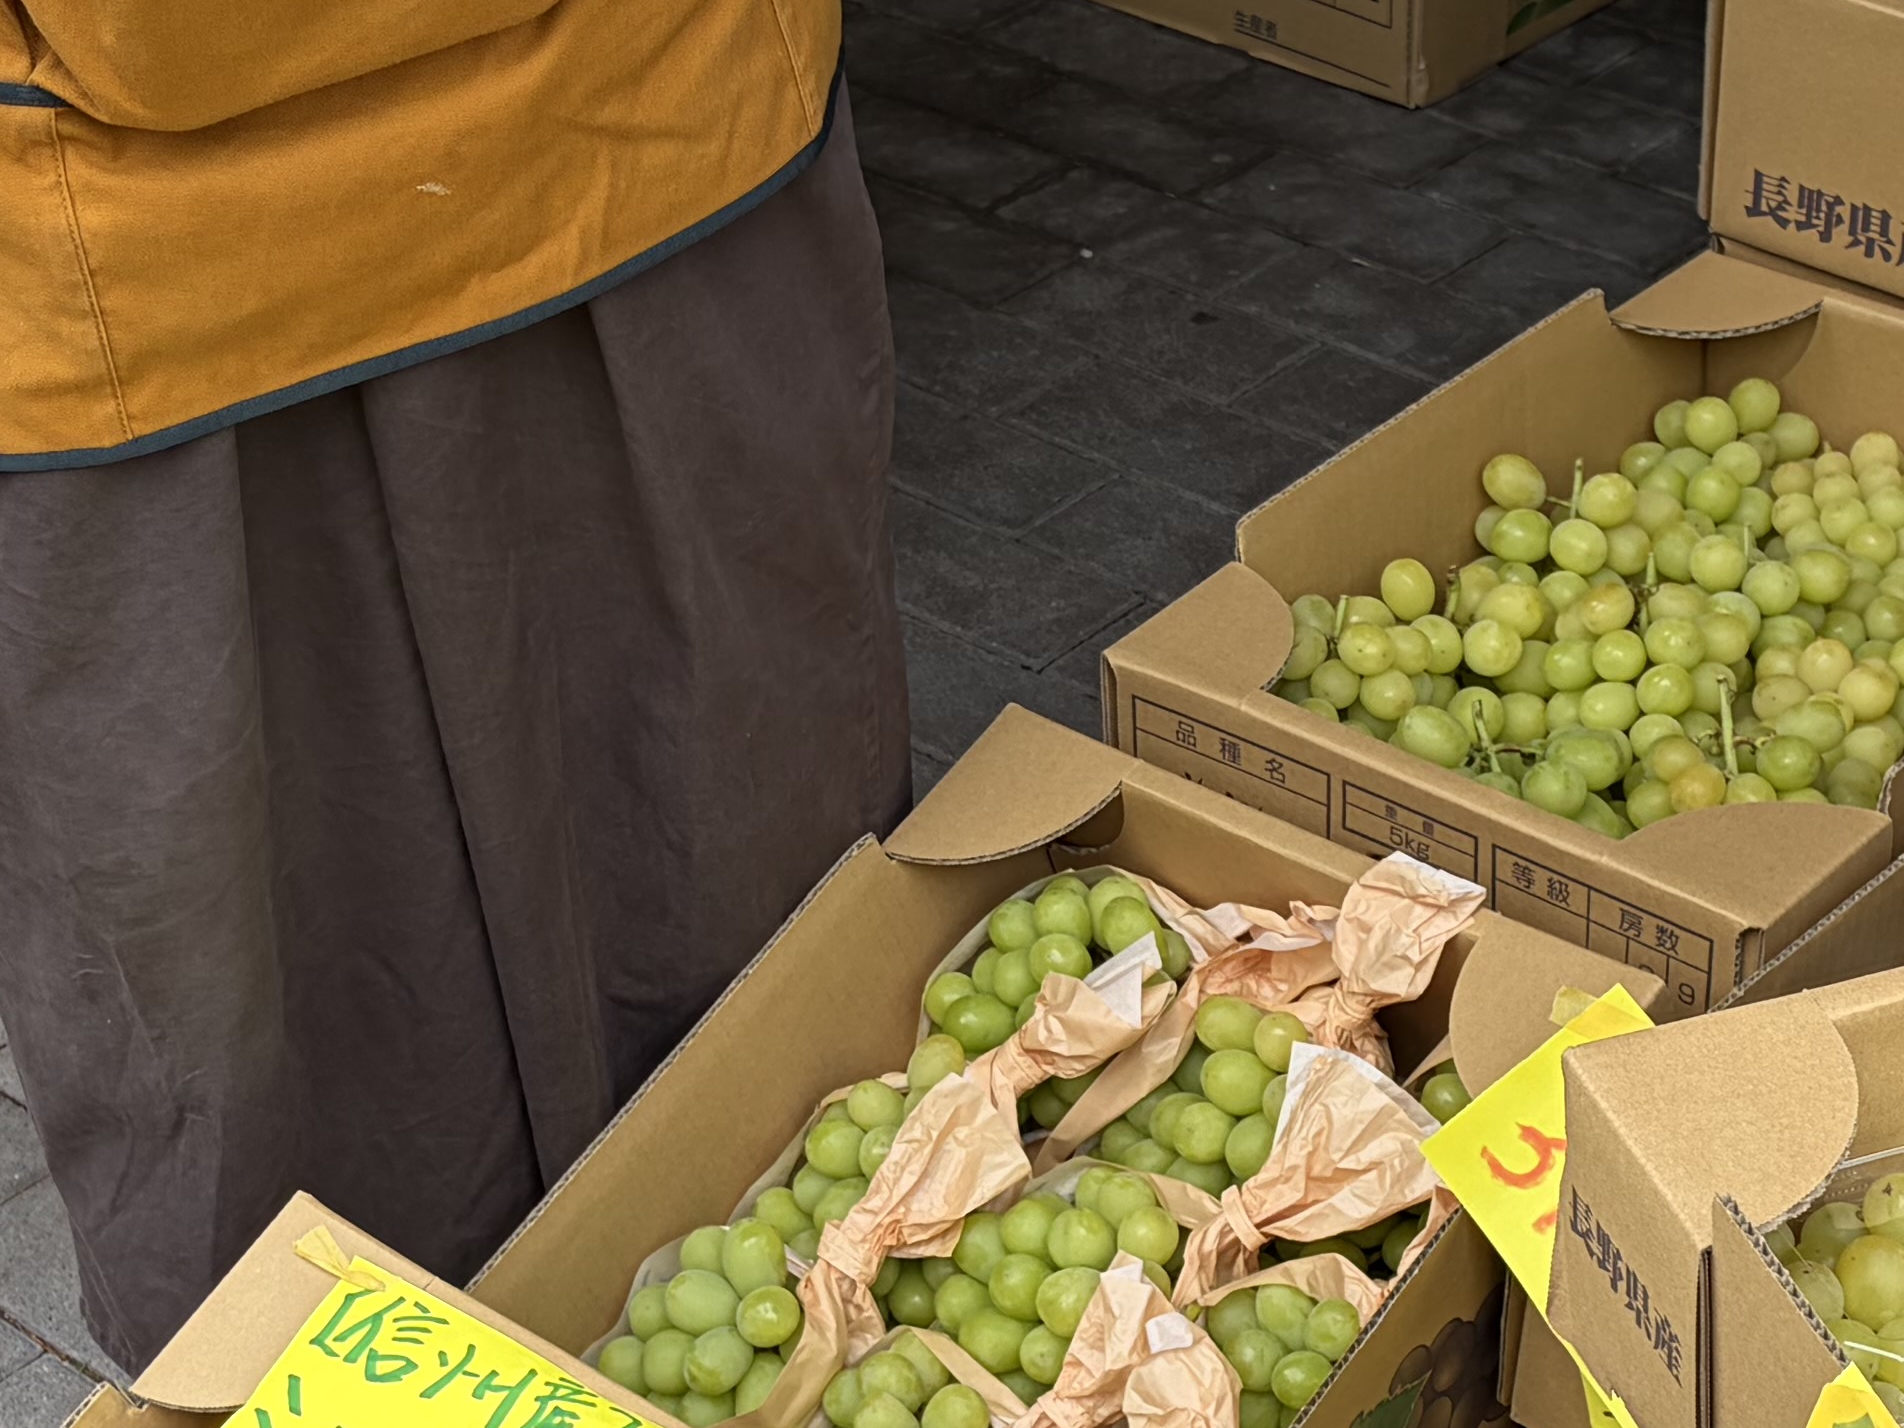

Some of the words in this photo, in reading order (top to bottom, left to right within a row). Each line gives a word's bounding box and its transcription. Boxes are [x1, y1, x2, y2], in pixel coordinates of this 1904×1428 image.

[1234, 10, 1278, 40] 生産者
[1176, 719, 1287, 784] 品種名
[1389, 824, 1430, 862] 5kg
[1512, 862, 1571, 908] 等級
[1618, 908, 1681, 956] 房数
[1679, 983, 1695, 1005] 9
[1571, 1184, 1684, 1387] 長野県産
